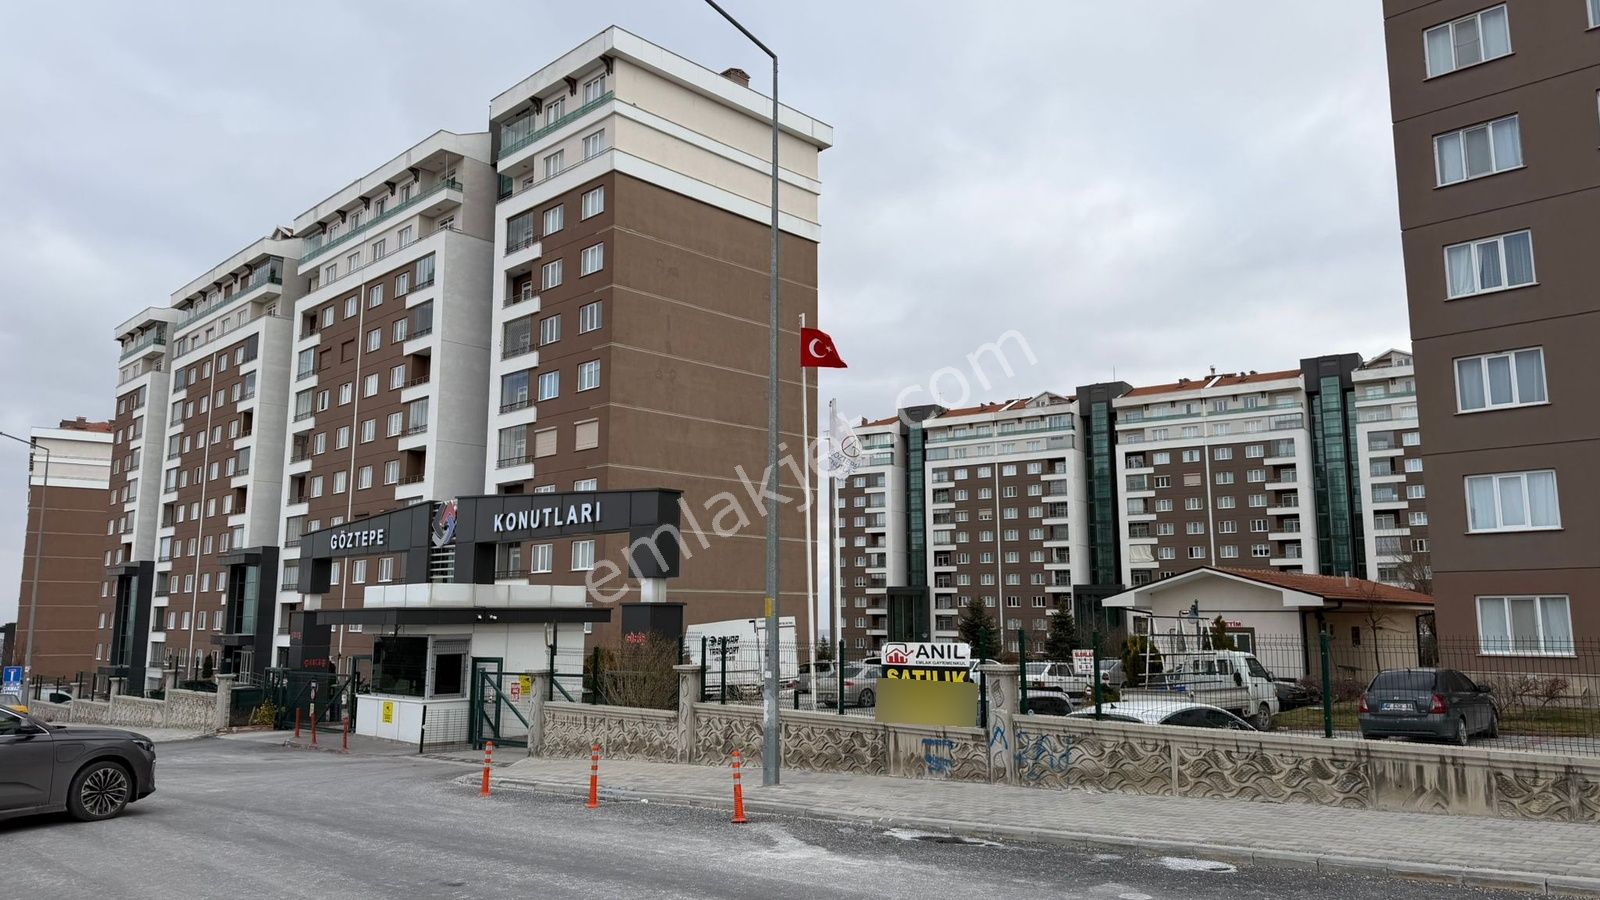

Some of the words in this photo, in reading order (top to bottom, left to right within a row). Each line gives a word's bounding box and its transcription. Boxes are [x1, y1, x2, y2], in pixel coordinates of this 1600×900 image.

[330, 528, 385, 550] GÖZTEPE
[493, 501, 601, 533] KONUTLARI
[915, 644, 966, 659] ANIL
